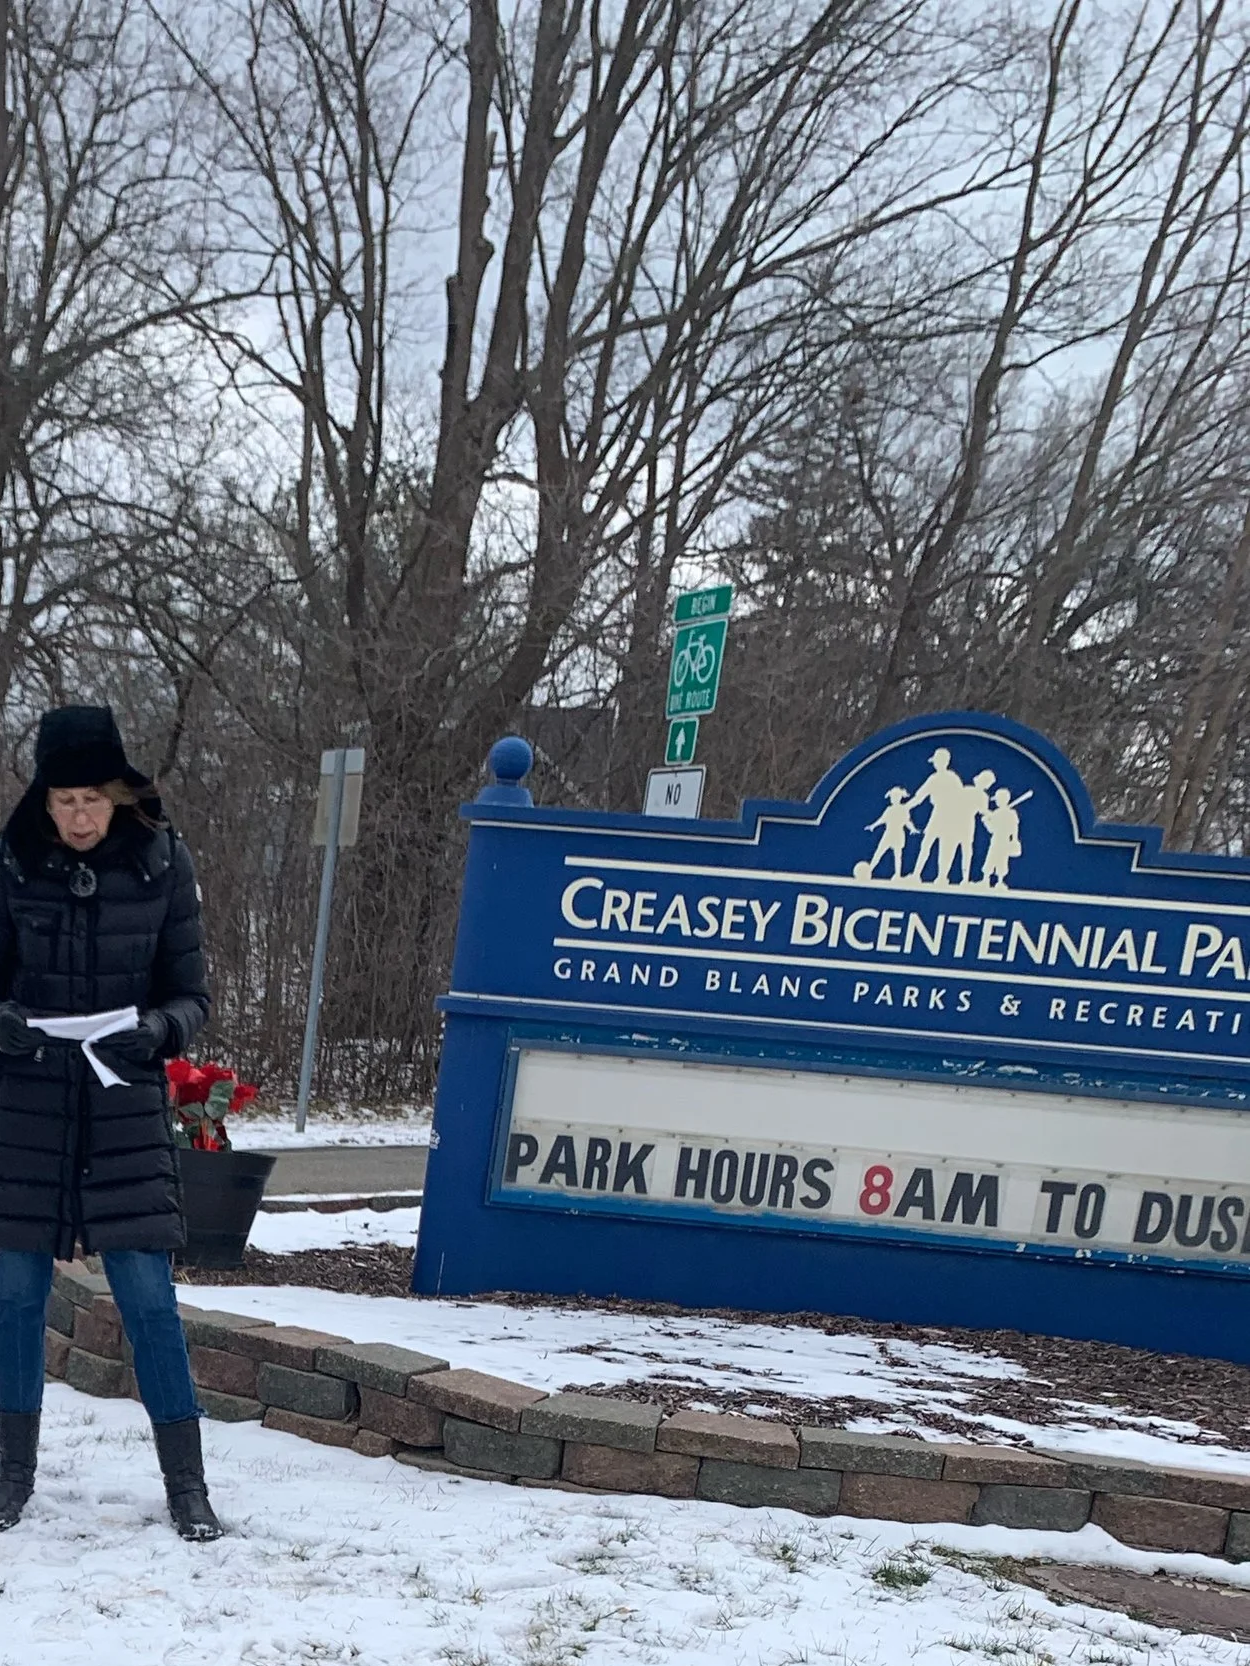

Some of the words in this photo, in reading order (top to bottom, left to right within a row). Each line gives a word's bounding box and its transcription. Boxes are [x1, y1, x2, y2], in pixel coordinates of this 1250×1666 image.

[690, 594, 717, 615] BEGIN
[685, 688, 711, 709] ROUTE
[664, 783, 682, 806] NO
[561, 876, 782, 942] CREASEY
[790, 894, 1167, 974] BICENTENNIAL
[1179, 923, 1250, 981] PA
[553, 957, 680, 988] GRAND
[705, 968, 828, 1000] BLANC
[853, 981, 972, 1012] PARKS
[1000, 994, 1021, 1016] &
[504, 1133, 655, 1195] PARK
[674, 1146, 835, 1210] HOURS
[859, 1165, 1000, 1228] 8AM
[1040, 1180, 1106, 1239] TO
[1133, 1190, 1250, 1255] DUS
